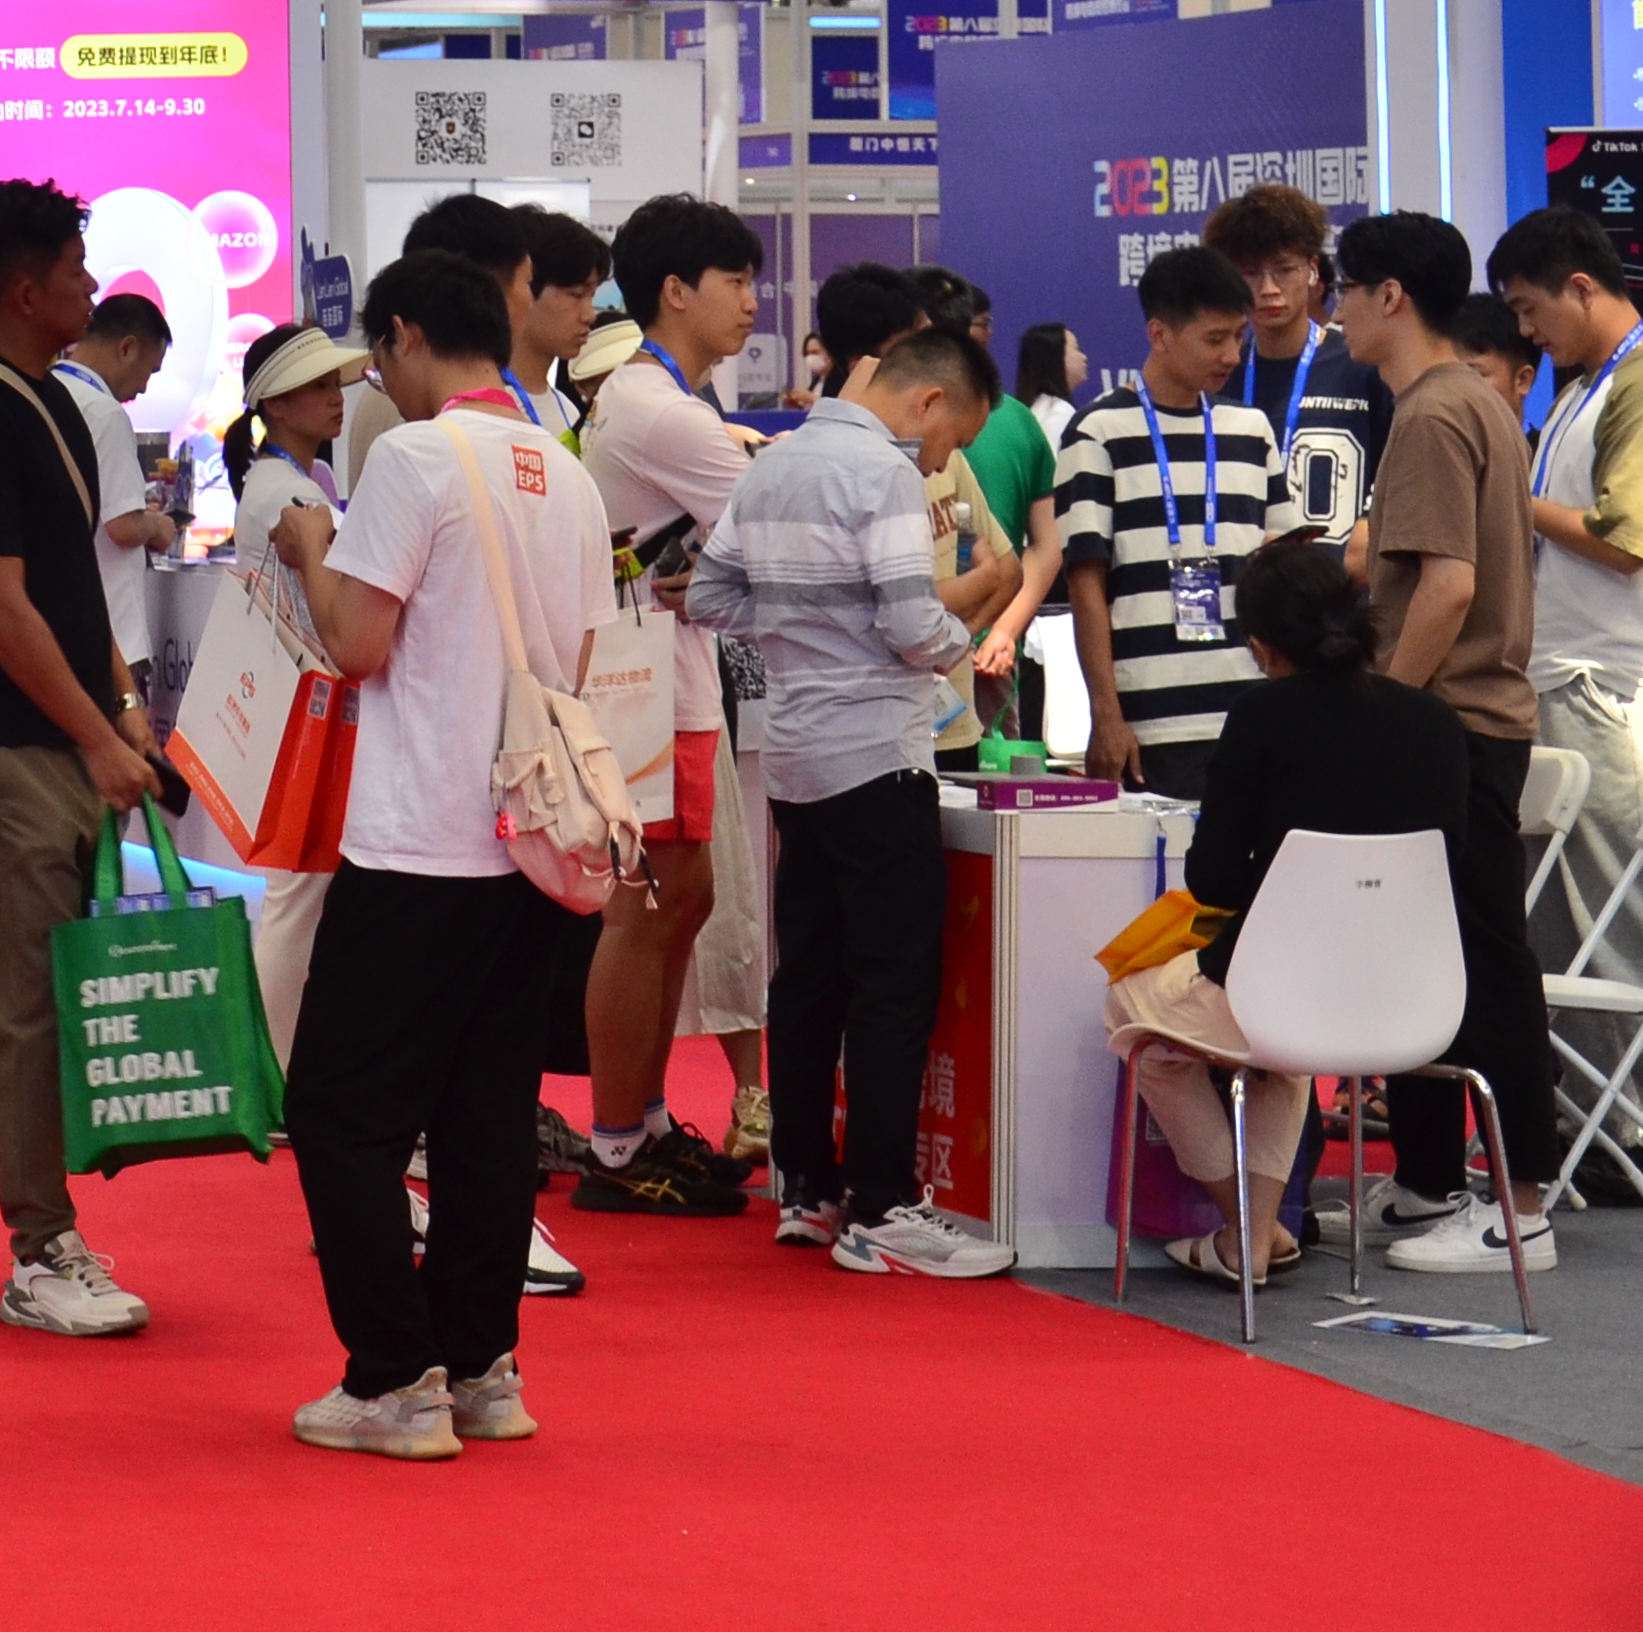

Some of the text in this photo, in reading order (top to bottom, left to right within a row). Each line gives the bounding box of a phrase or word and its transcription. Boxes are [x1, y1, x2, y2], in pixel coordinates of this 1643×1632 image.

[1603, 141, 1638, 153] TikTok
[518, 470, 544, 491] EPS
[80, 966, 220, 1008] SIMPLIFY
[82, 1014, 142, 1047] THE
[86, 1050, 203, 1087] GLOBAL
[91, 1085, 235, 1128] PAYMENT
